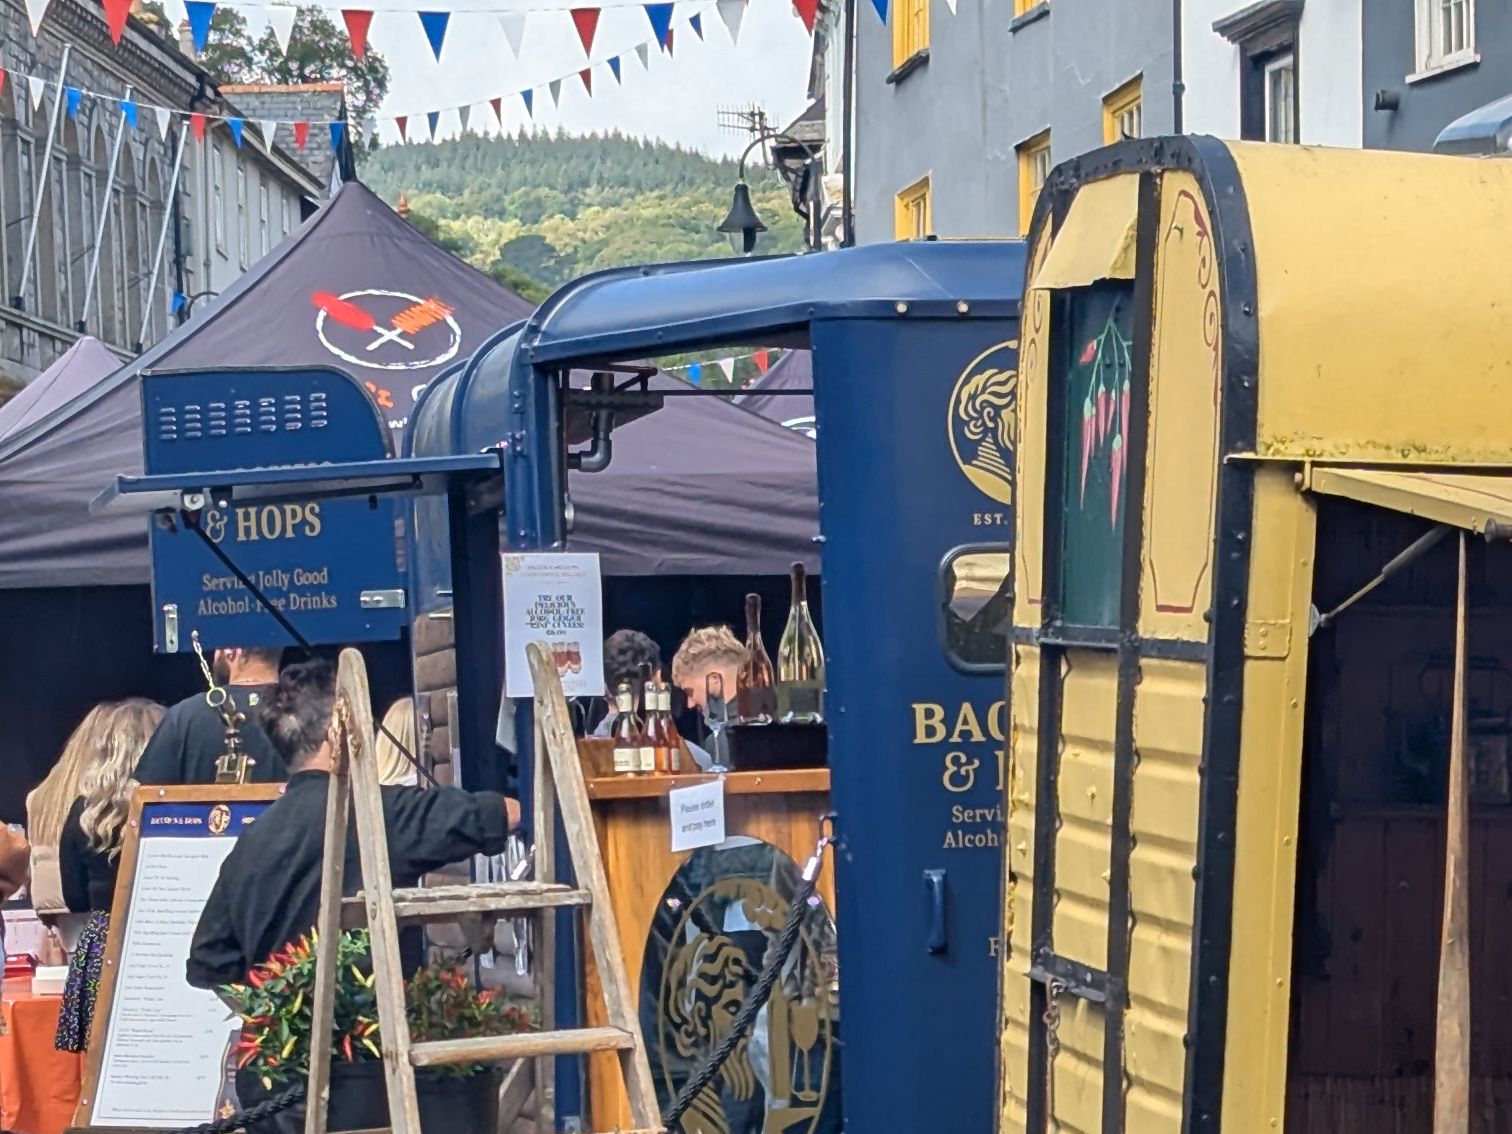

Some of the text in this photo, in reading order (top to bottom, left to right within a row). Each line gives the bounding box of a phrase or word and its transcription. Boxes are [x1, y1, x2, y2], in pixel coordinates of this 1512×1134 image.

[206, 502, 322, 543] & HOPS
[973, 513, 1008, 526] EST.
[202, 566, 328, 593] Servi Jolly Good
[290, 592, 338, 612] Drinks
[943, 751, 980, 792] &
